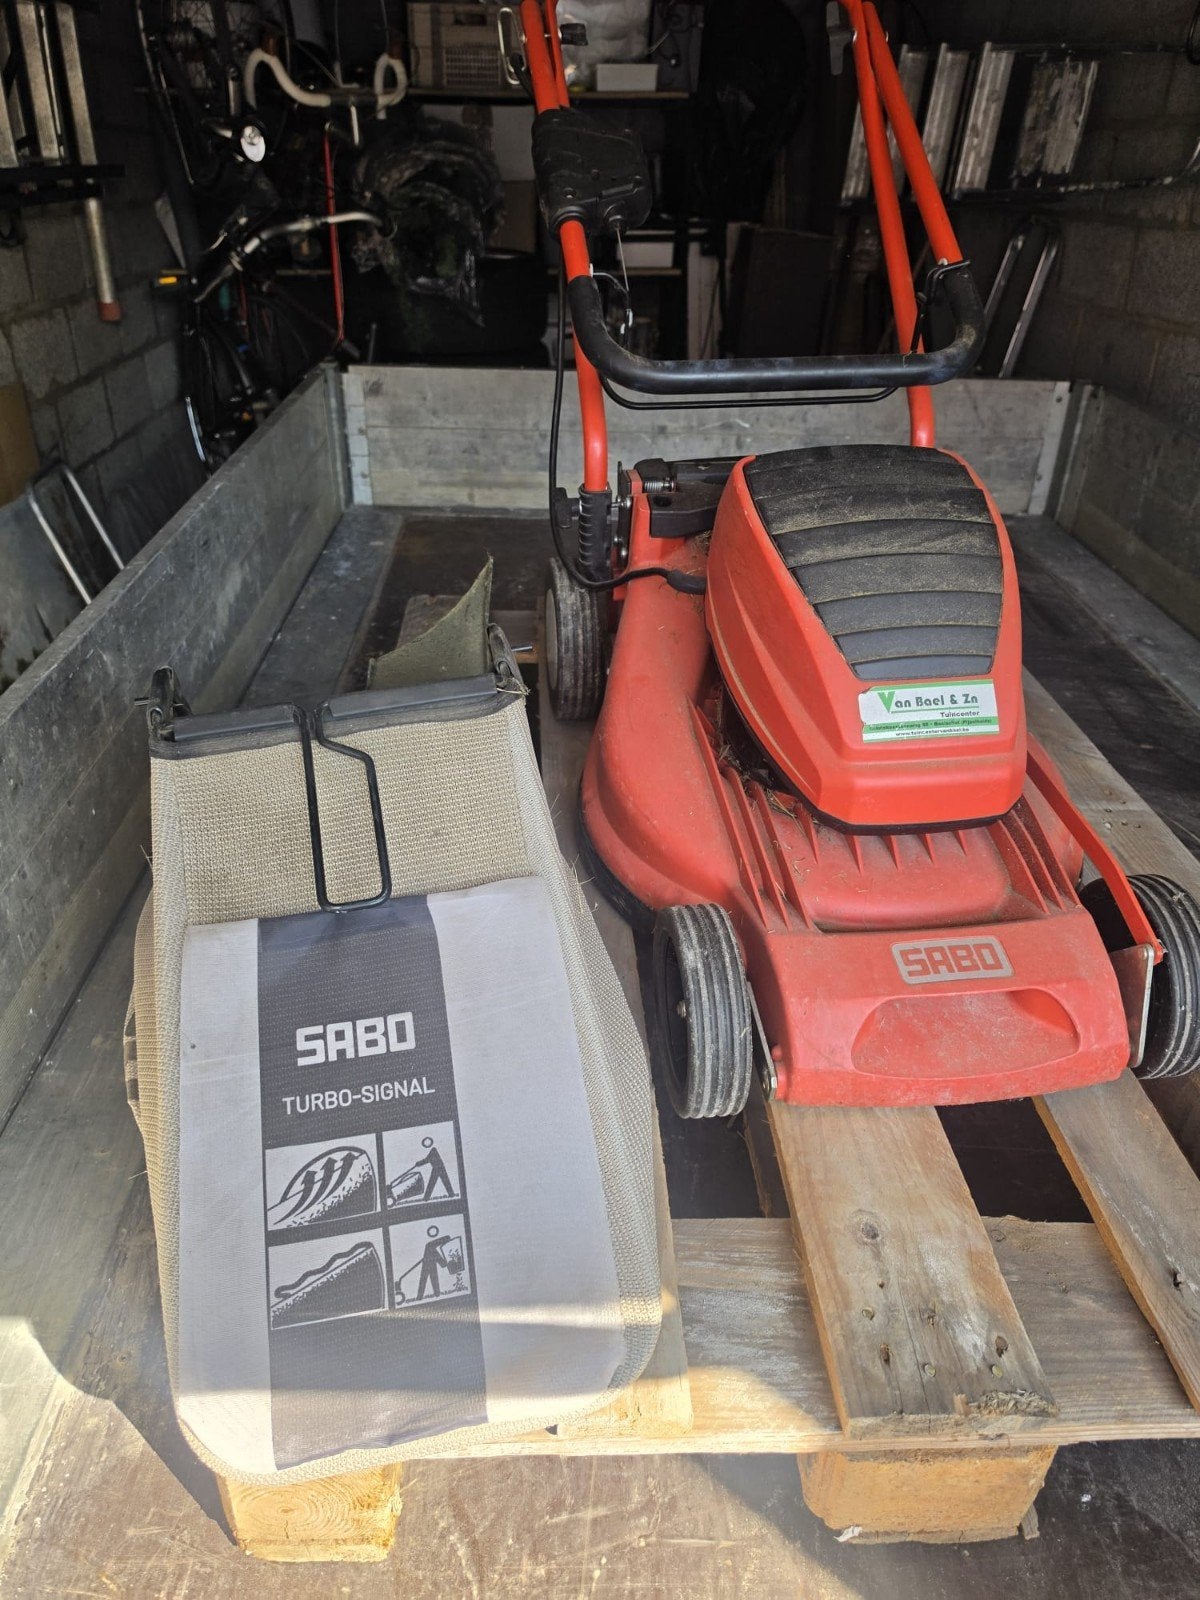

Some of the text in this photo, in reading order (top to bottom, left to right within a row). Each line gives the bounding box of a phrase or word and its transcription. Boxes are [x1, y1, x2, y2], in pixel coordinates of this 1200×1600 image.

[877, 690, 978, 713] Van Bael & Zn
[940, 710, 980, 718] Tuincenter
[899, 943, 1004, 977] SABO
[296, 1011, 416, 1066] SABO
[282, 1076, 436, 1115] TURBO-SIGNAL
